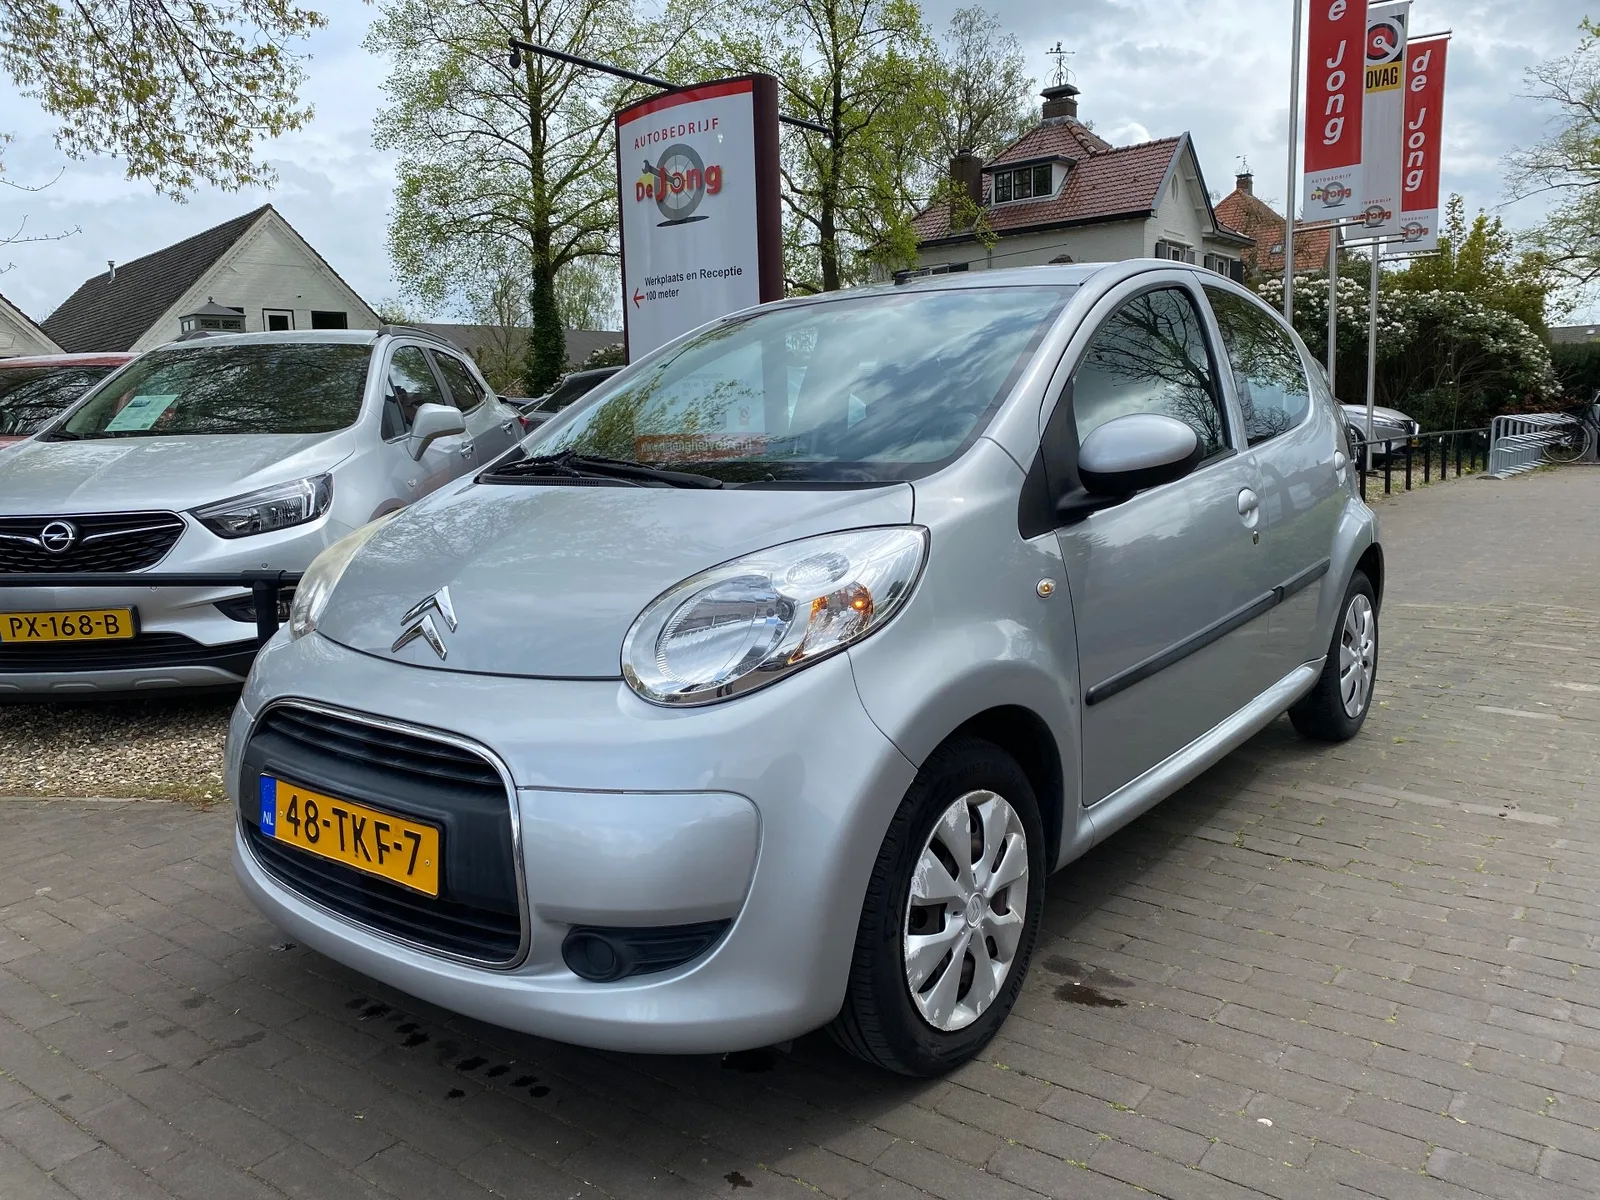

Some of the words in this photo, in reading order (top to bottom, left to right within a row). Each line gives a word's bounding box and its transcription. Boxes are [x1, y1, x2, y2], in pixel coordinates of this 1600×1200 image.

[1328, 0, 1347, 21] e
[1366, 66, 1398, 89] OVAG
[1410, 50, 1432, 92] de
[1322, 40, 1347, 145] Jong
[634, 117, 720, 150] AUTOBEDRIJF
[1404, 107, 1426, 192] Jong
[636, 182, 653, 202] De
[654, 163, 722, 202] Jong
[1311, 173, 1352, 183] AUTOBEDRIJF
[644, 273, 684, 287] Werkplaats
[686, 271, 697, 281] en
[700, 266, 743, 281] Receptie
[645, 290, 656, 301] 100
[658, 288, 679, 299] meter
[9, 614, 120, 638] PX-168-B
[262, 810, 274, 826] NL
[286, 794, 422, 876] 48-TKF-7
